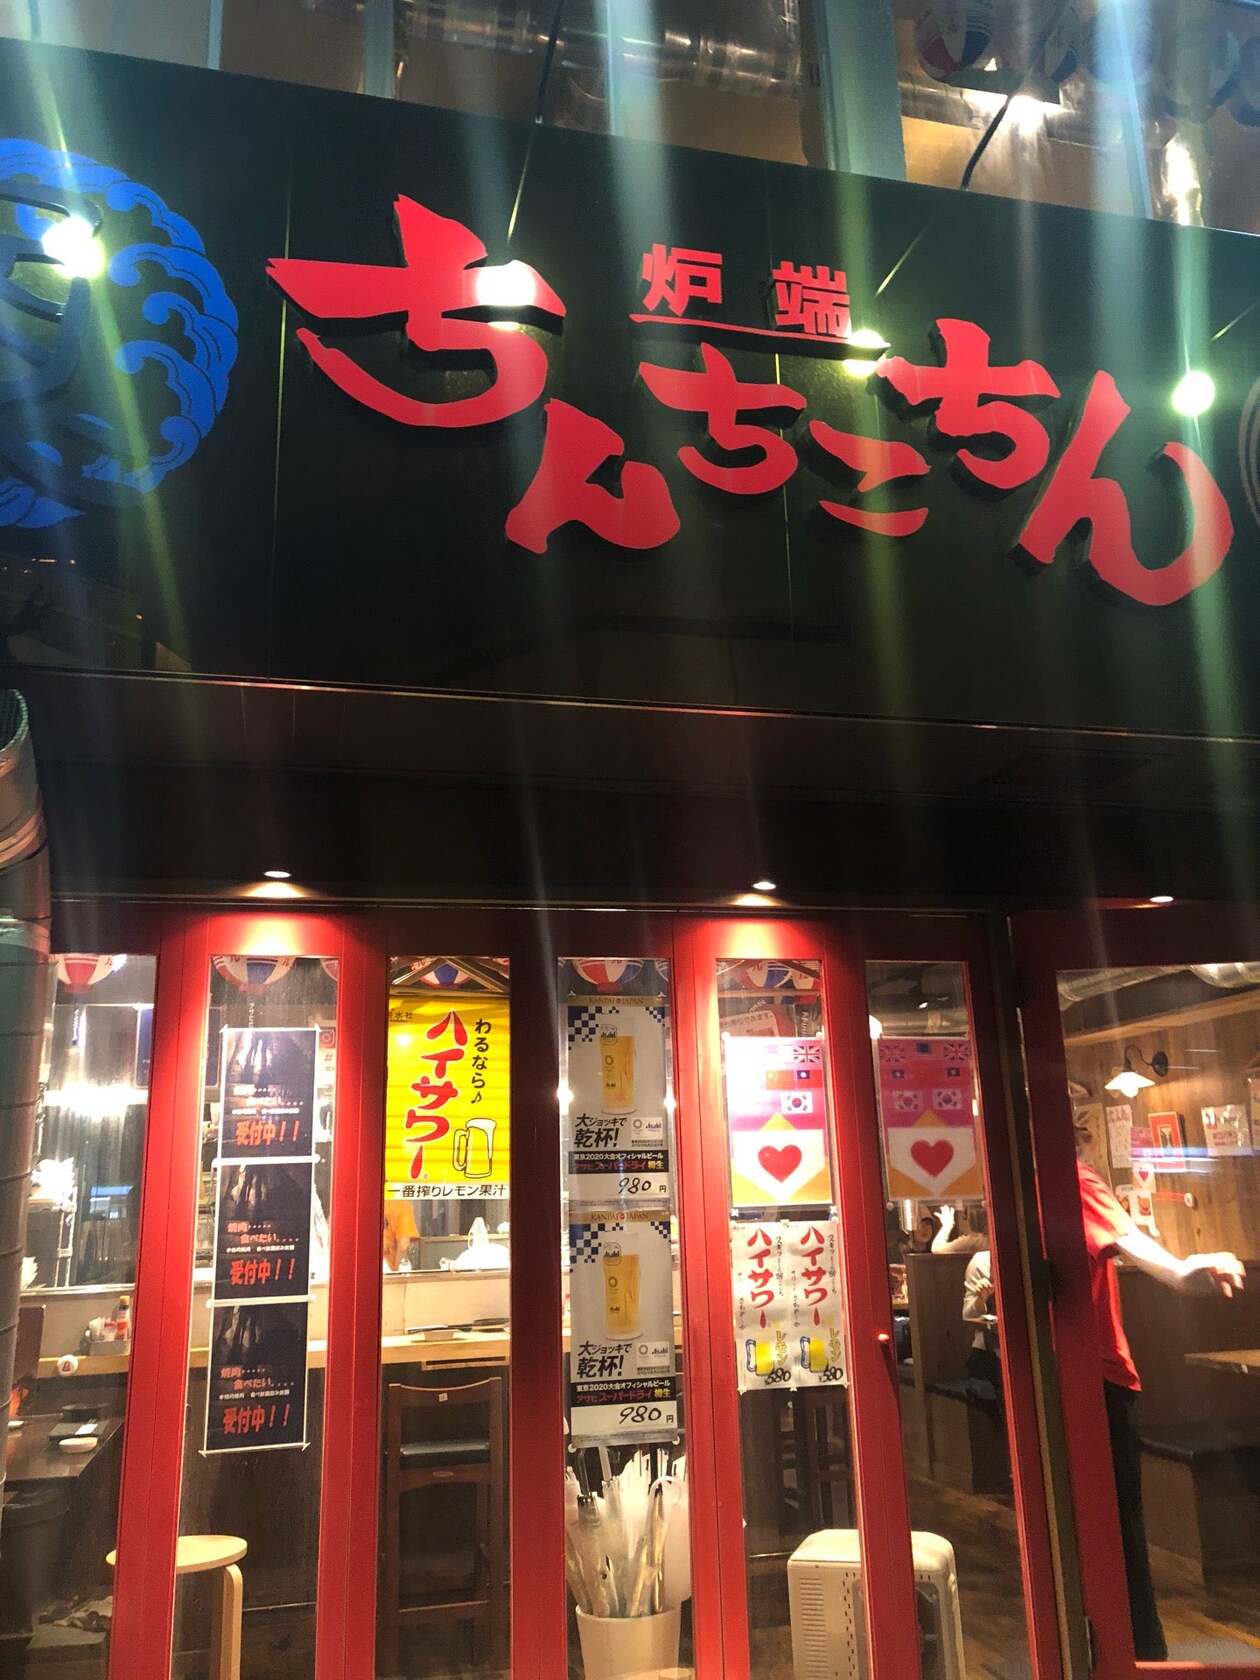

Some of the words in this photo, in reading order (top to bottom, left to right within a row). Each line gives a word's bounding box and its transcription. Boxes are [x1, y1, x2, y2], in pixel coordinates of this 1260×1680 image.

[641, 243, 852, 340] 炉端
[267, 193, 1234, 607] ちんちこちん
[404, 1010, 469, 1180] ハイサワー
[574, 1112, 628, 1128] 大ジョッキで
[386, 1183, 507, 1199] 一番搾りレモン果汁
[618, 1177, 652, 1195] 980
[747, 1227, 775, 1329] ハイサワー
[800, 1225, 829, 1327] ハイサワー
[577, 1340, 633, 1357] 大ジョッキで
[619, 1405, 662, 1425] 980
[666, 1414, 674, 1424] 円
